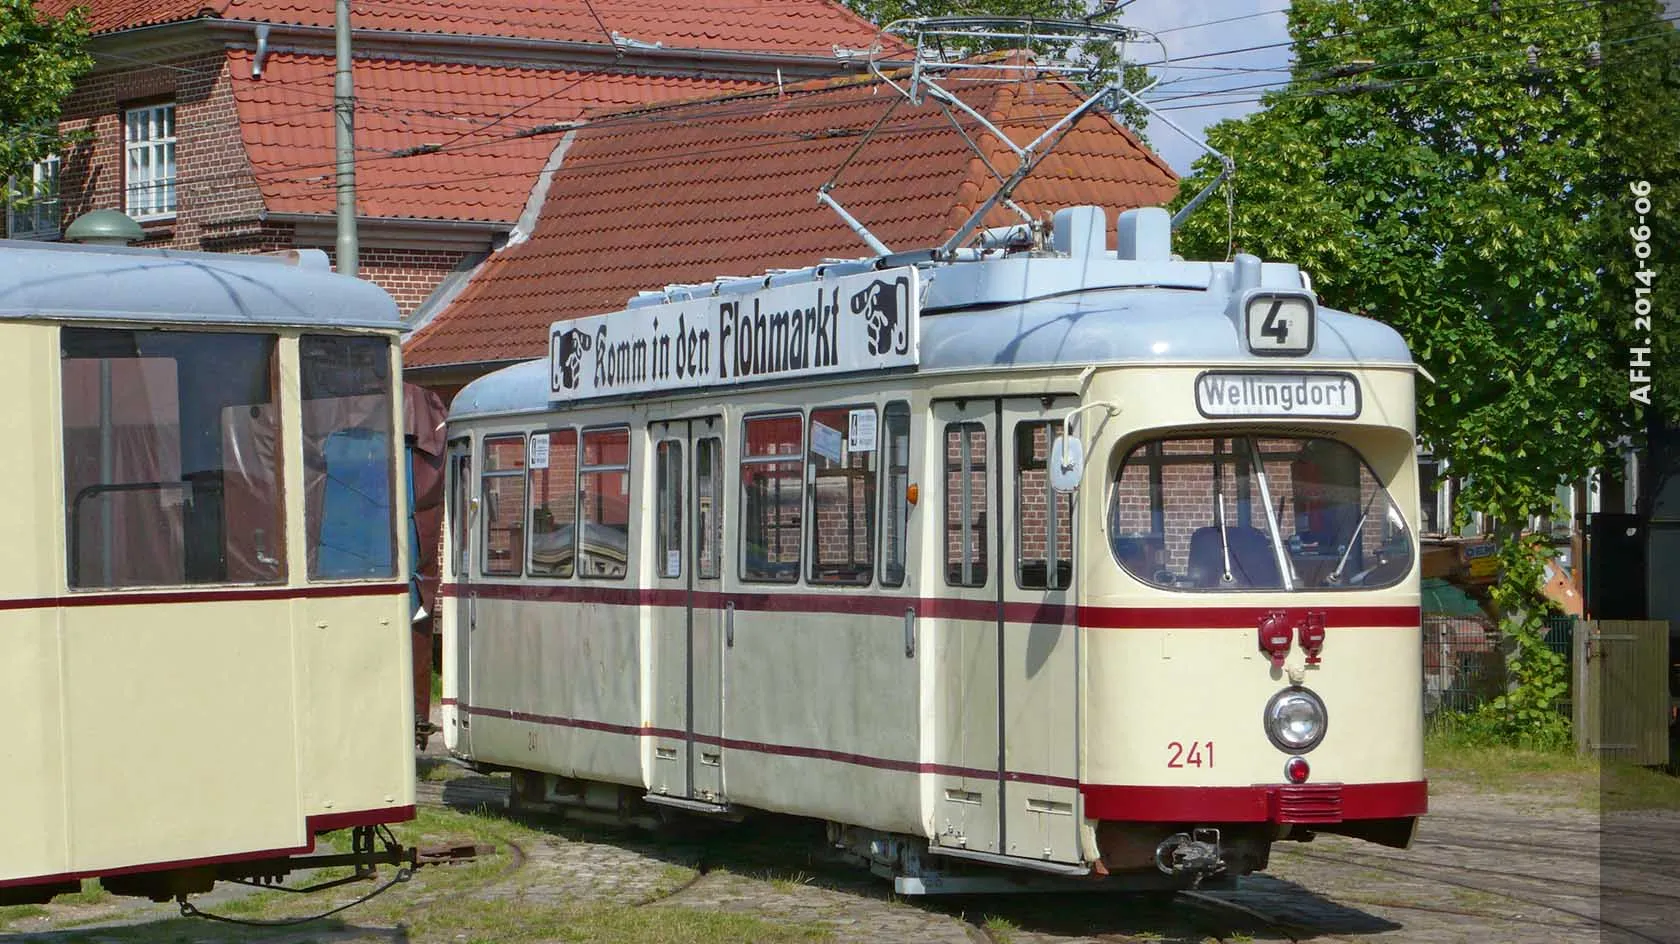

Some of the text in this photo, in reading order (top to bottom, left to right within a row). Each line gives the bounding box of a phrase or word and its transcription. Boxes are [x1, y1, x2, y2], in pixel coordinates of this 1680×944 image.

[593, 285, 839, 388] Komm in den Flohmarkt
[1260, 300, 1289, 345] 4
[1203, 375, 1348, 412] Wellingdorf
[1167, 741, 1215, 769] 241
